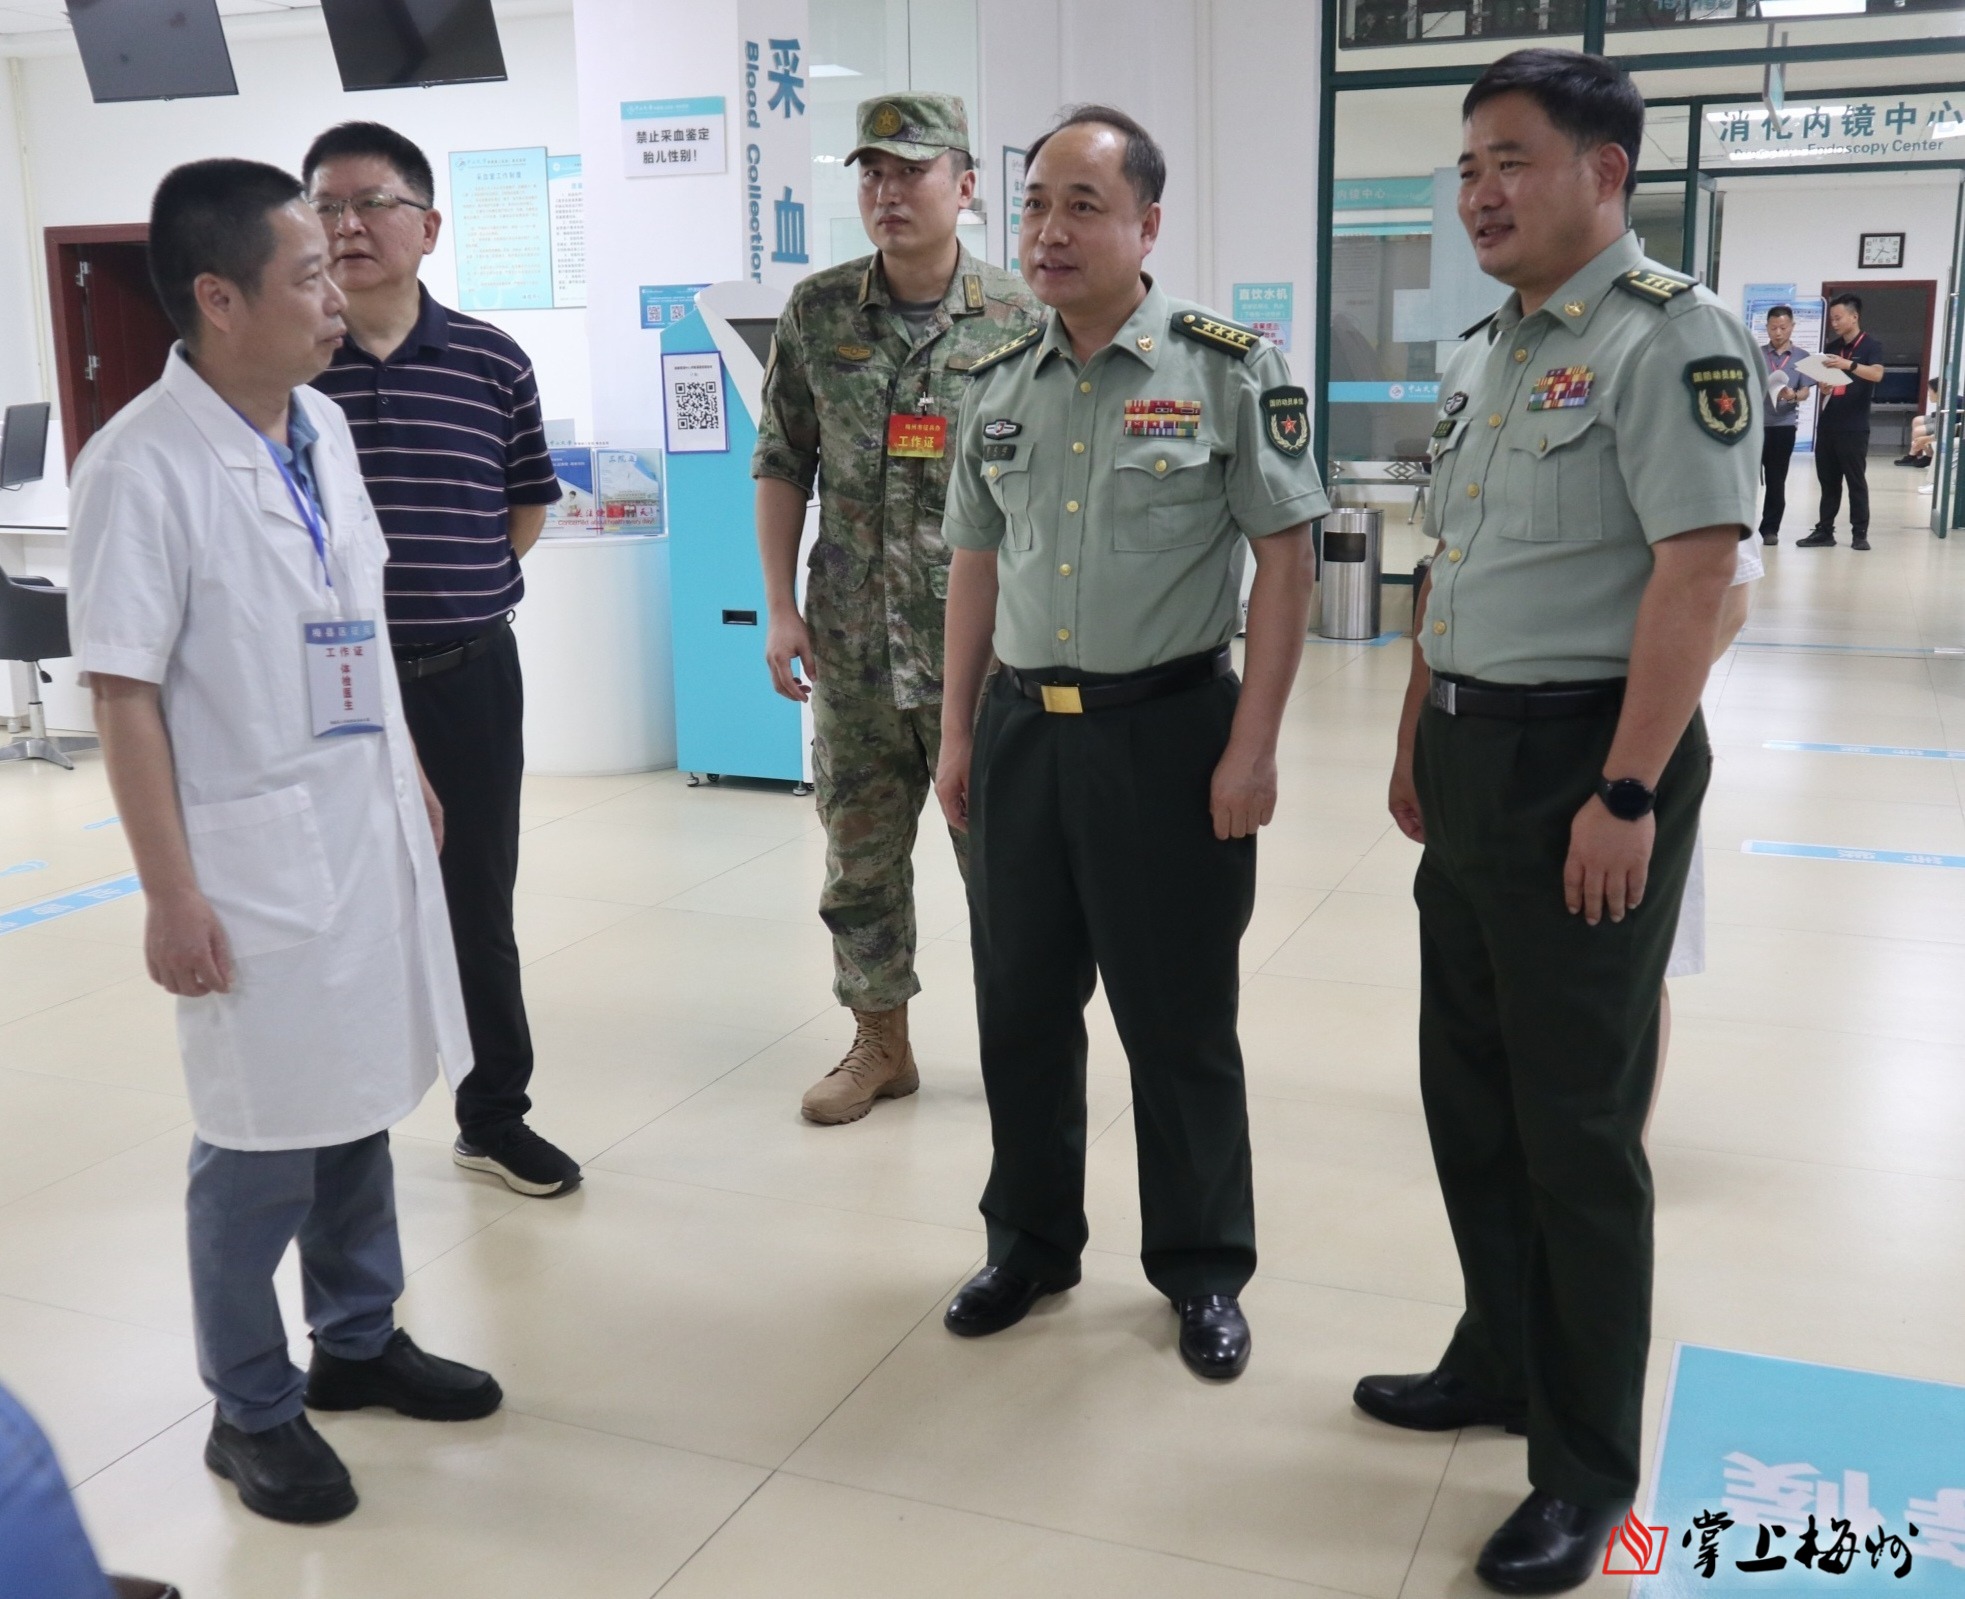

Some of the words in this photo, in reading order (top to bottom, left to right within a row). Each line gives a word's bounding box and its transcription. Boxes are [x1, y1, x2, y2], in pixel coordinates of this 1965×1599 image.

[744, 40, 761, 129] Blood
[1719, 100, 1965, 142] 消化内镜中心
[636, 128, 710, 144] 禁止采血鉴定
[768, 38, 810, 265] 采血
[1892, 139, 1944, 152] Center
[898, 435, 935, 448] 工作证
[326, 646, 364, 658] 工作证
